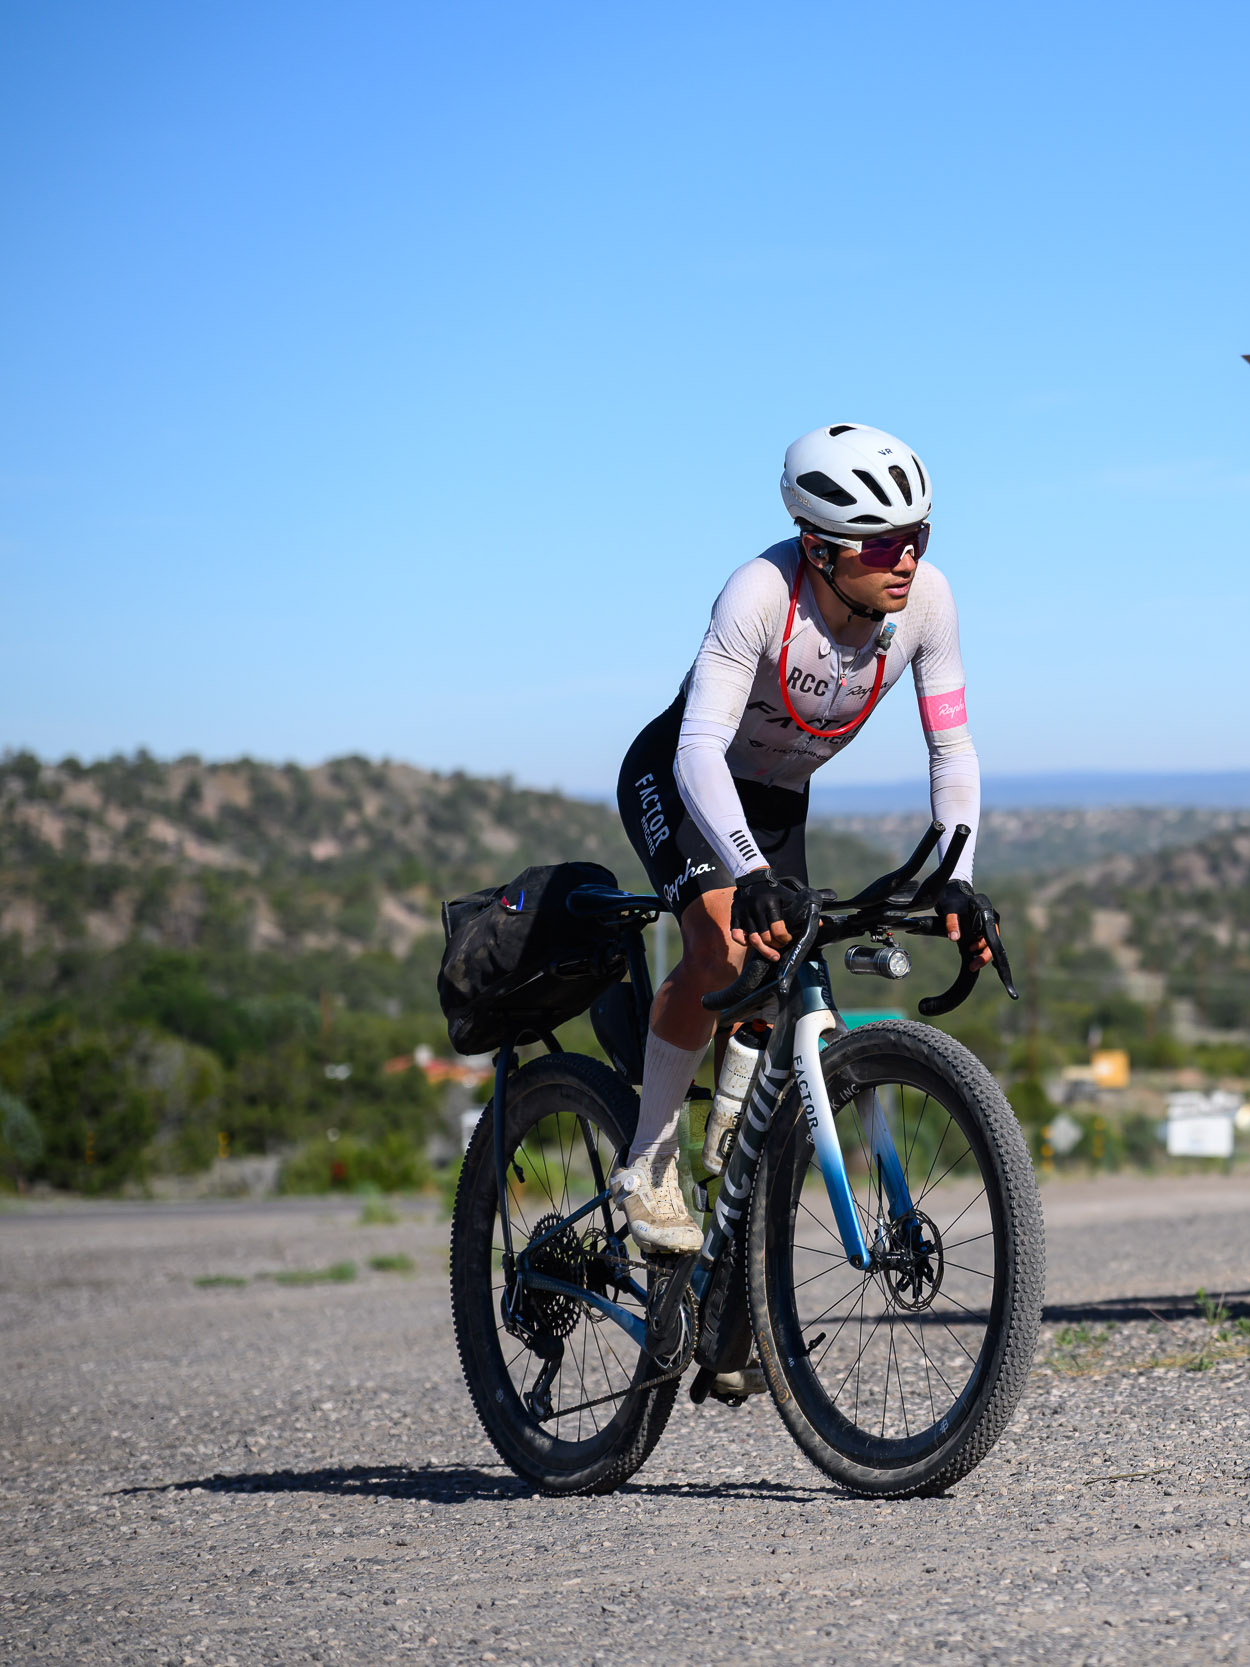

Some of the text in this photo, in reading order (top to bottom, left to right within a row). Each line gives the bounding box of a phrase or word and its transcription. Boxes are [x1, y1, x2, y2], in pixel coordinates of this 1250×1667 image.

[787, 666, 828, 697] RCC
[634, 773, 670, 848] FACTOR
[793, 1055, 819, 1129] FACTOR
[840, 1083, 860, 1101] INC
